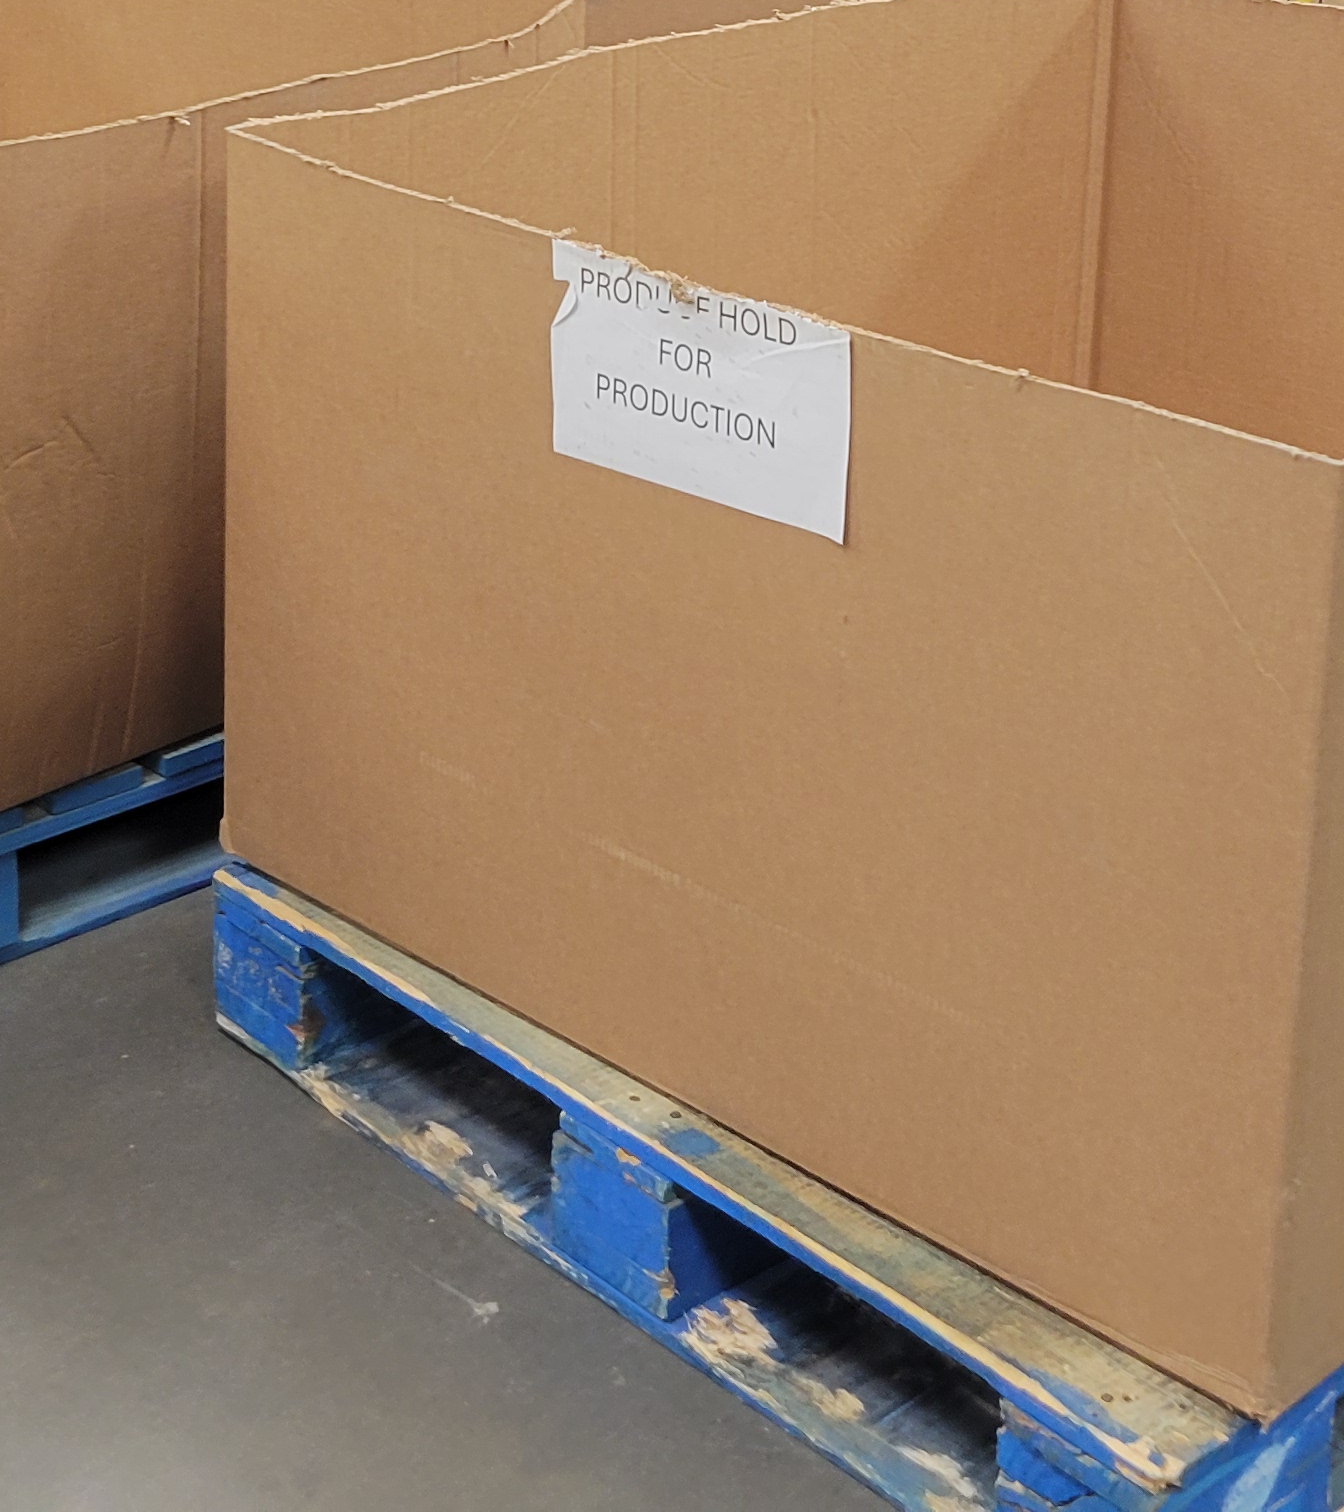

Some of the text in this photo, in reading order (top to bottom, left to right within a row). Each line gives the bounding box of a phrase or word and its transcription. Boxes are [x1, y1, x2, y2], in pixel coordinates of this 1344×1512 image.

[580, 266, 797, 346] PRODUE HOLD
[658, 338, 713, 379] FOR
[595, 373, 777, 449] PRODUCTION
